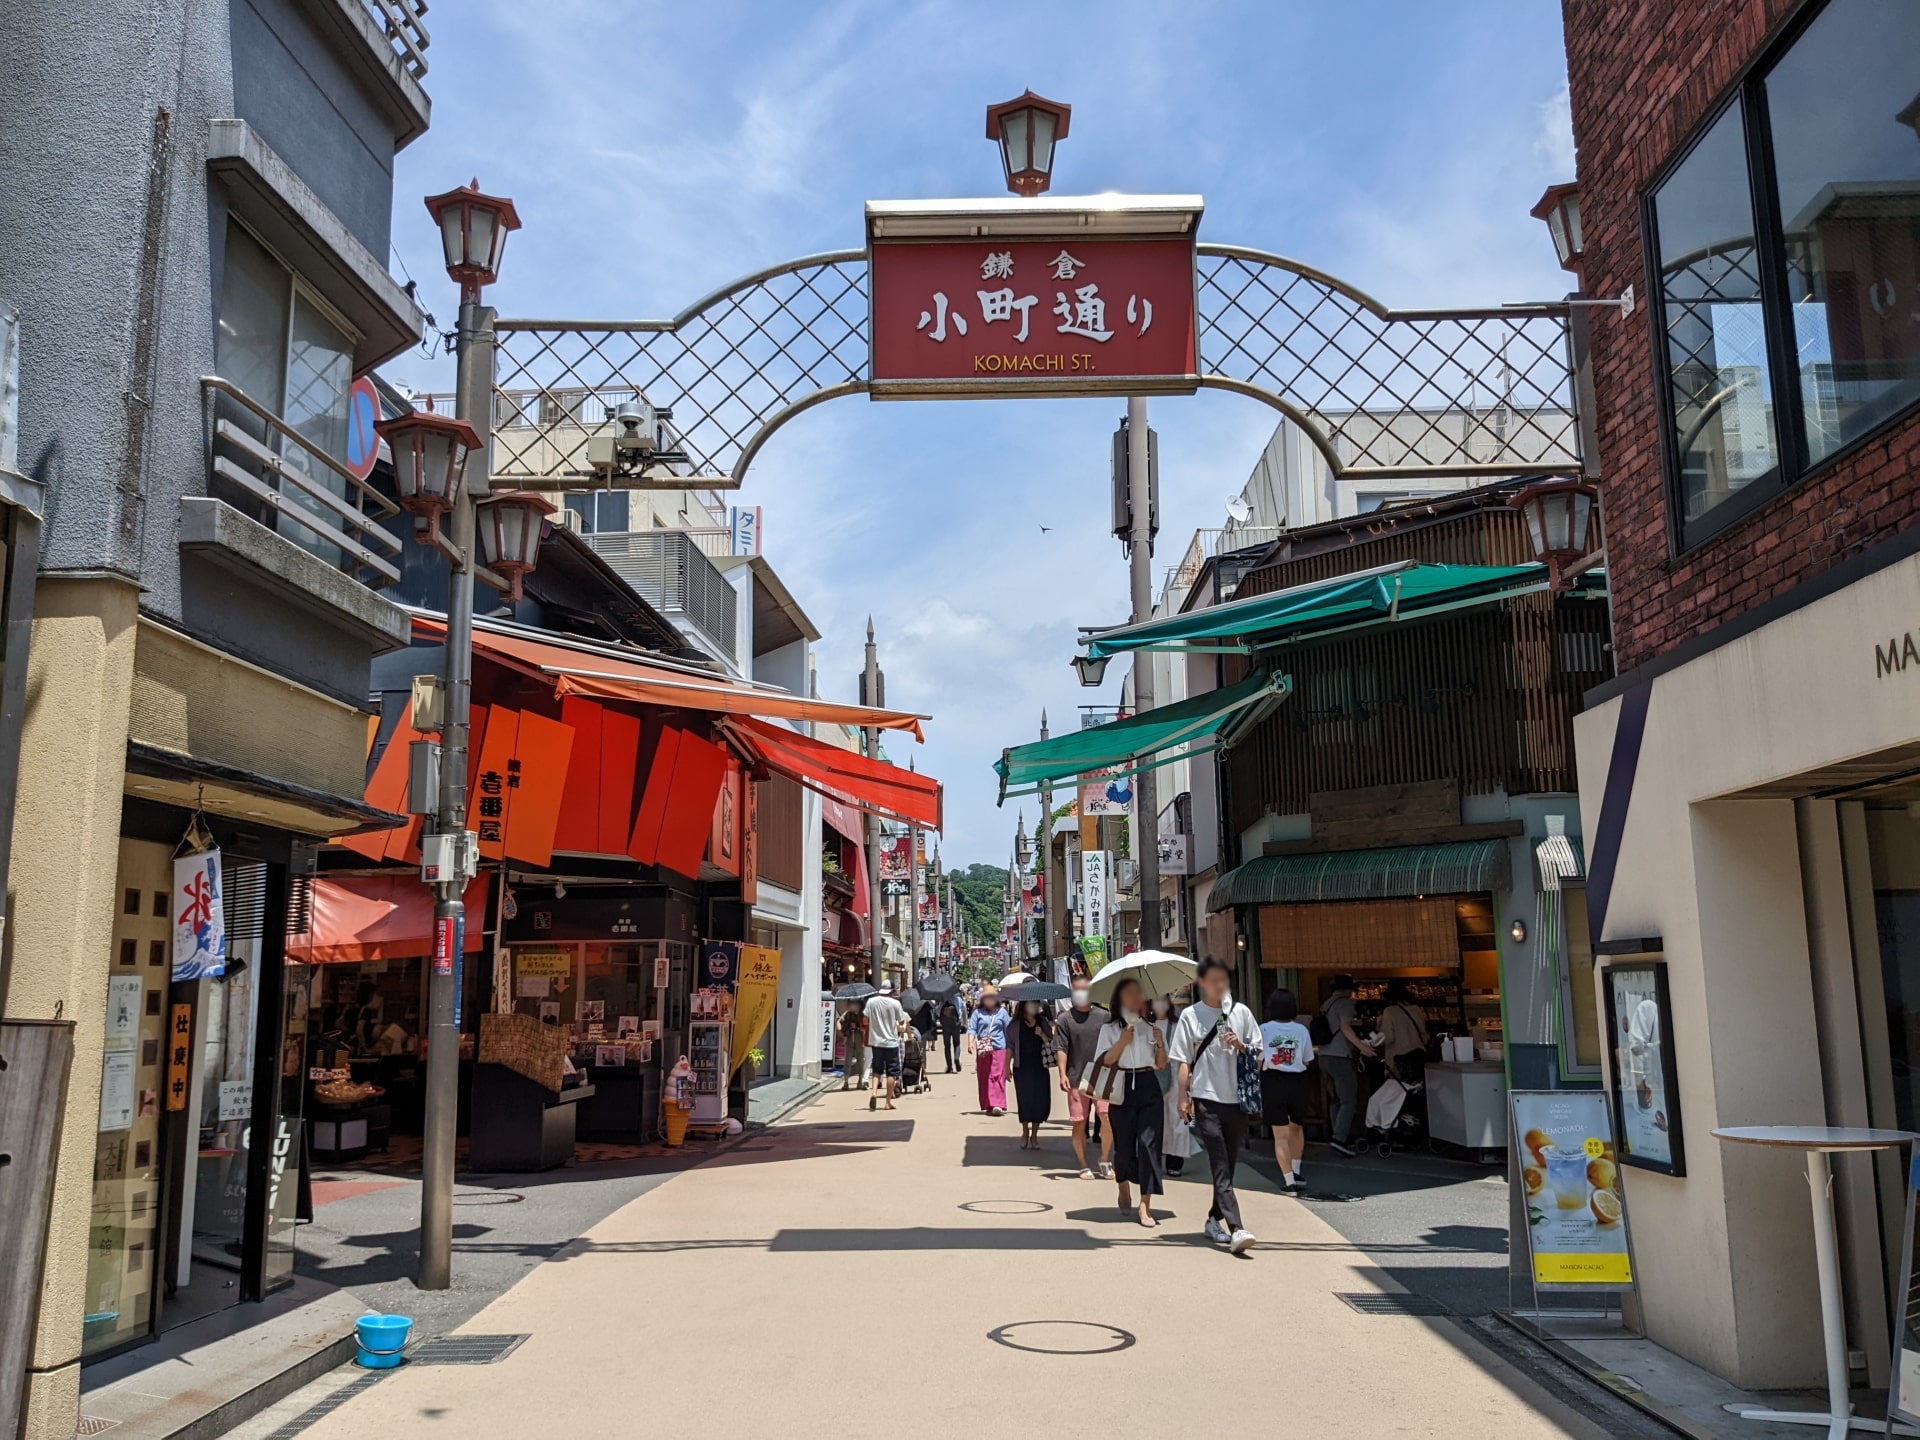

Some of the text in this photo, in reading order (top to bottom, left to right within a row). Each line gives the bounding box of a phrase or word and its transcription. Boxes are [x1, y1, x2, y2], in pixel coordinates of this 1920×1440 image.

[979, 249, 1087, 281] 鎌倉
[915, 283, 1153, 344] 小町通り
[973, 353, 1097, 373] KOMACHI ST.
[479, 770, 503, 843] 壱番屋
[178, 870, 212, 935] 氷
